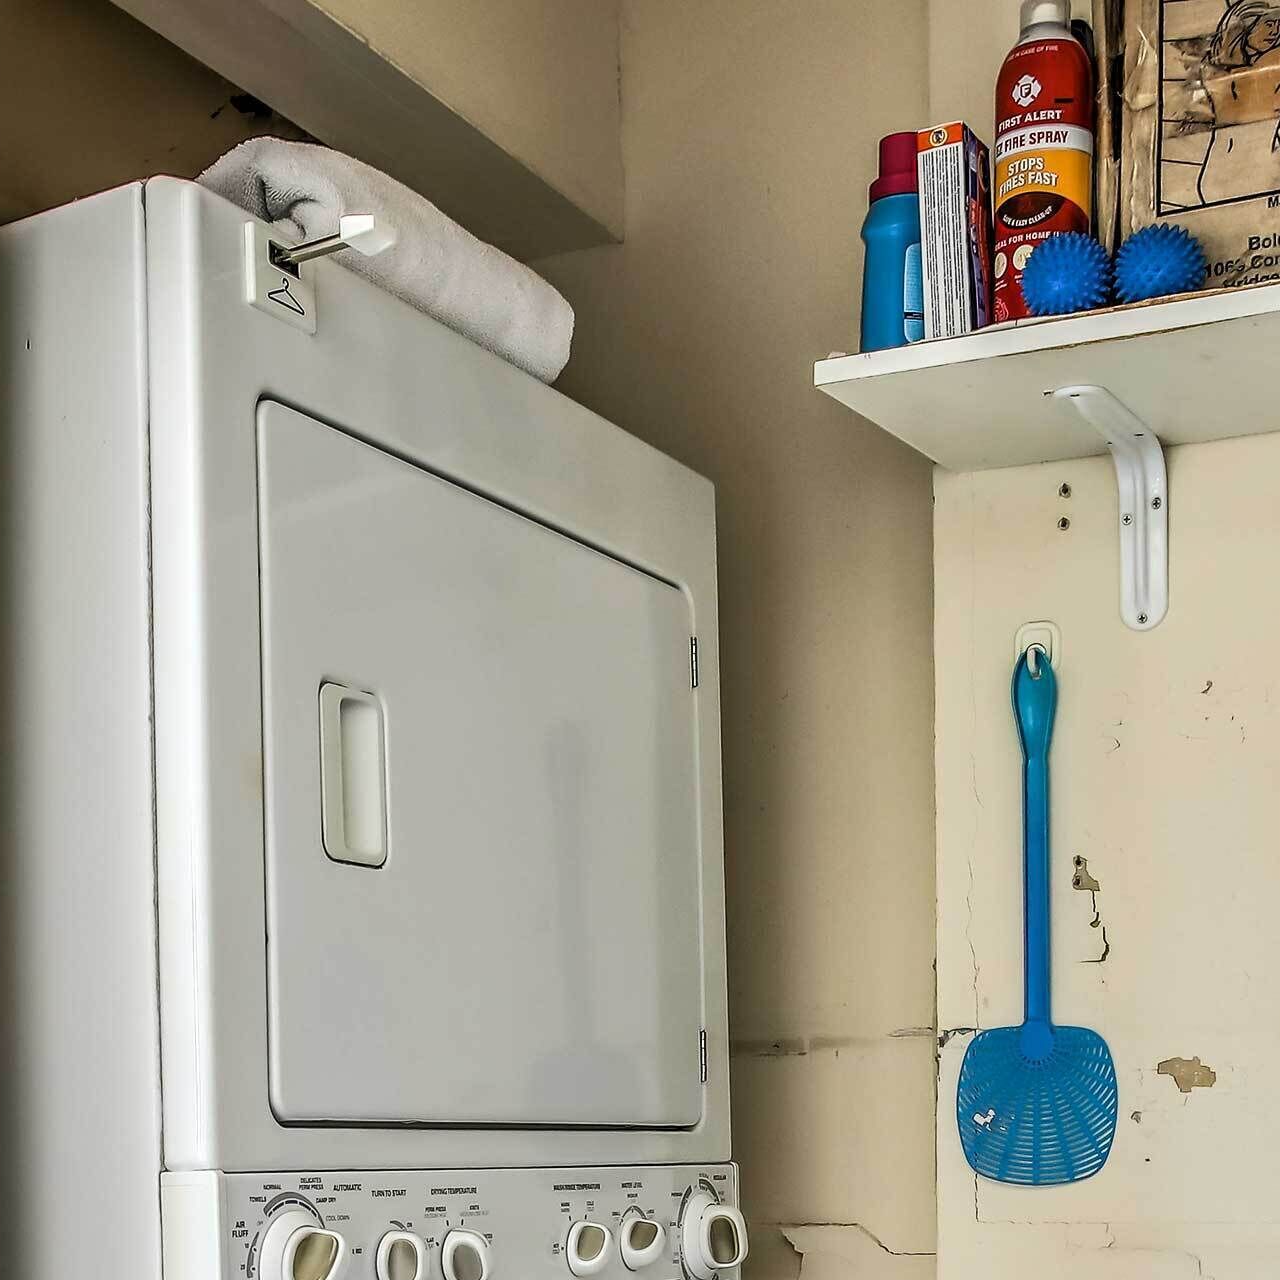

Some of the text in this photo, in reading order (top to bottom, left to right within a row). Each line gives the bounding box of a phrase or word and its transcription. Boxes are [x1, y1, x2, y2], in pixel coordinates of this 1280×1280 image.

[999, 110, 1062, 132] FIRST ALERT
[1005, 134, 1026, 151] FIRE
[1029, 131, 1068, 145] SPRAY
[1008, 157, 1045, 176] STOPS
[999, 171, 1058, 197] FIRES FAST
[1008, 233, 1024, 245] FOR
